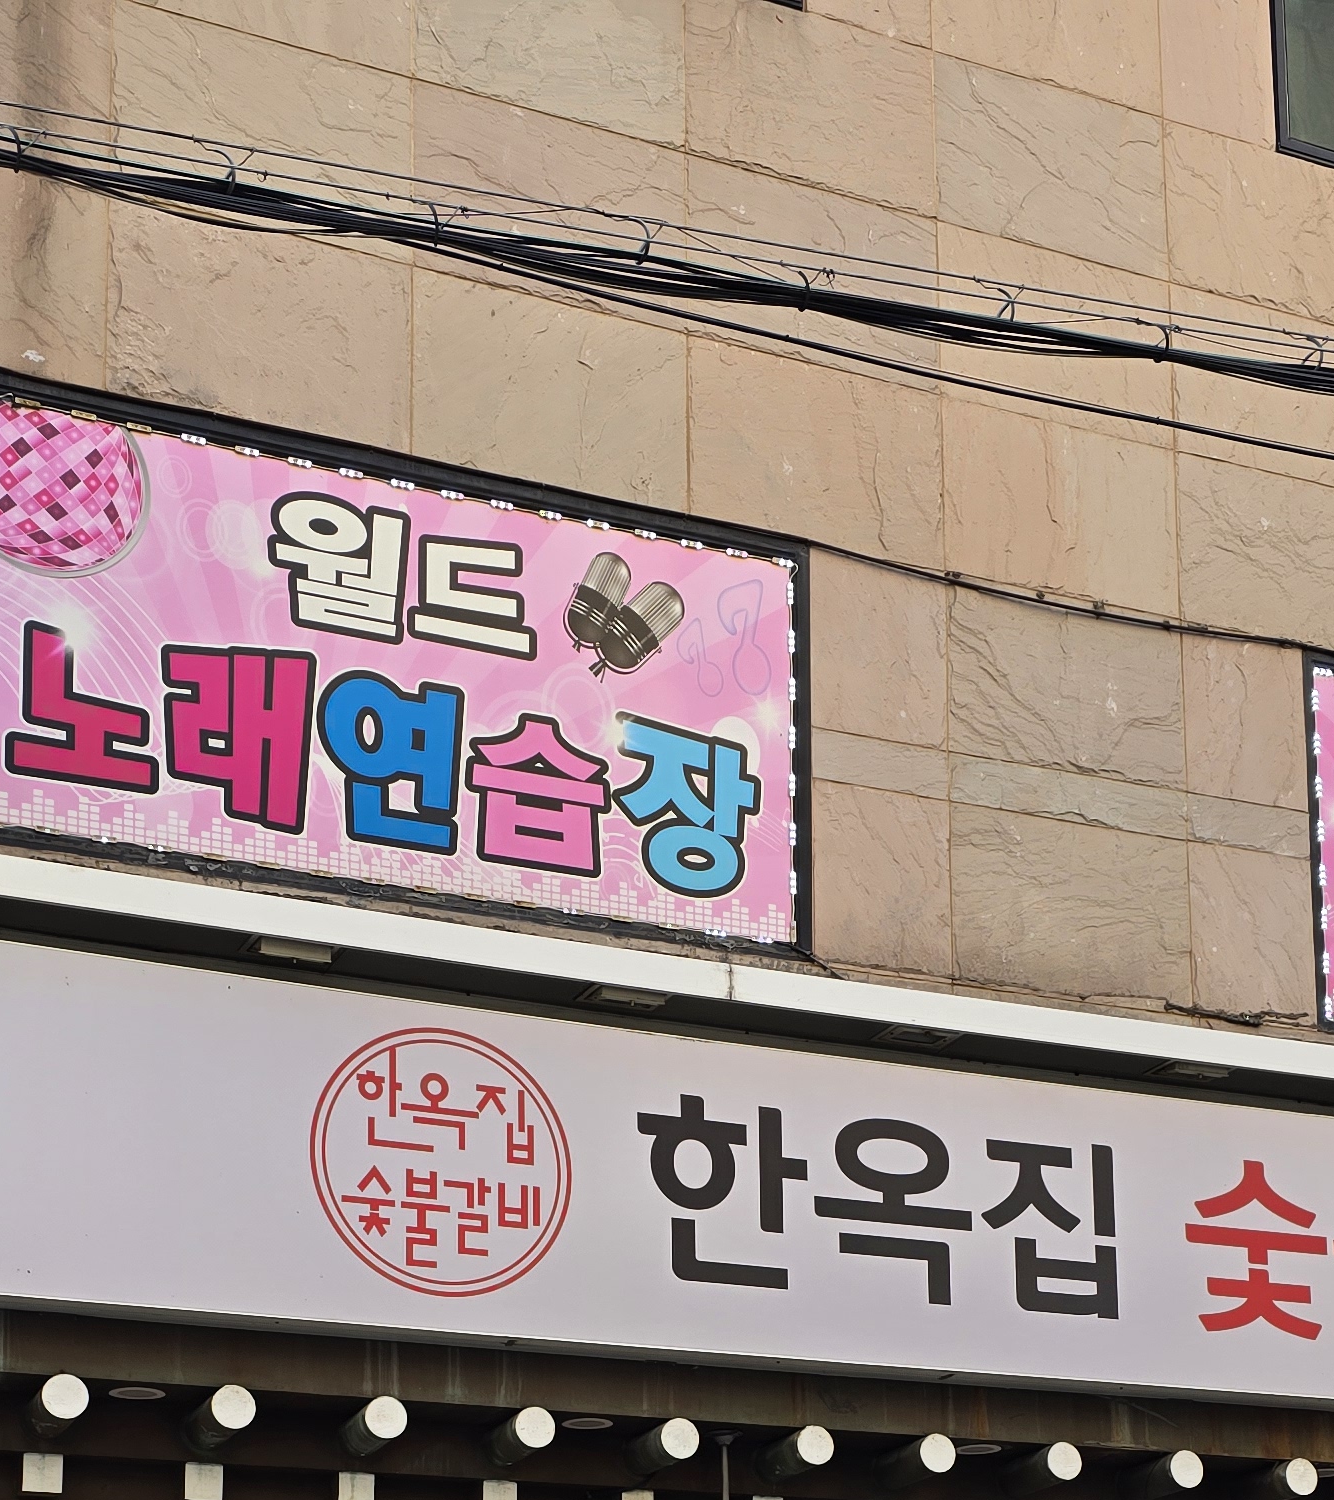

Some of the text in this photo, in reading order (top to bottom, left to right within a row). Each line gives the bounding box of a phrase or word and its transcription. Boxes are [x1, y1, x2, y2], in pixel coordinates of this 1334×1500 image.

[269, 490, 536, 661] 월드
[4, 619, 764, 898] 노래연습장
[356, 1047, 535, 1165] 한옥집
[341, 1165, 541, 1268] 숯불갈비
[637, 1093, 1119, 1320] 한옥집
